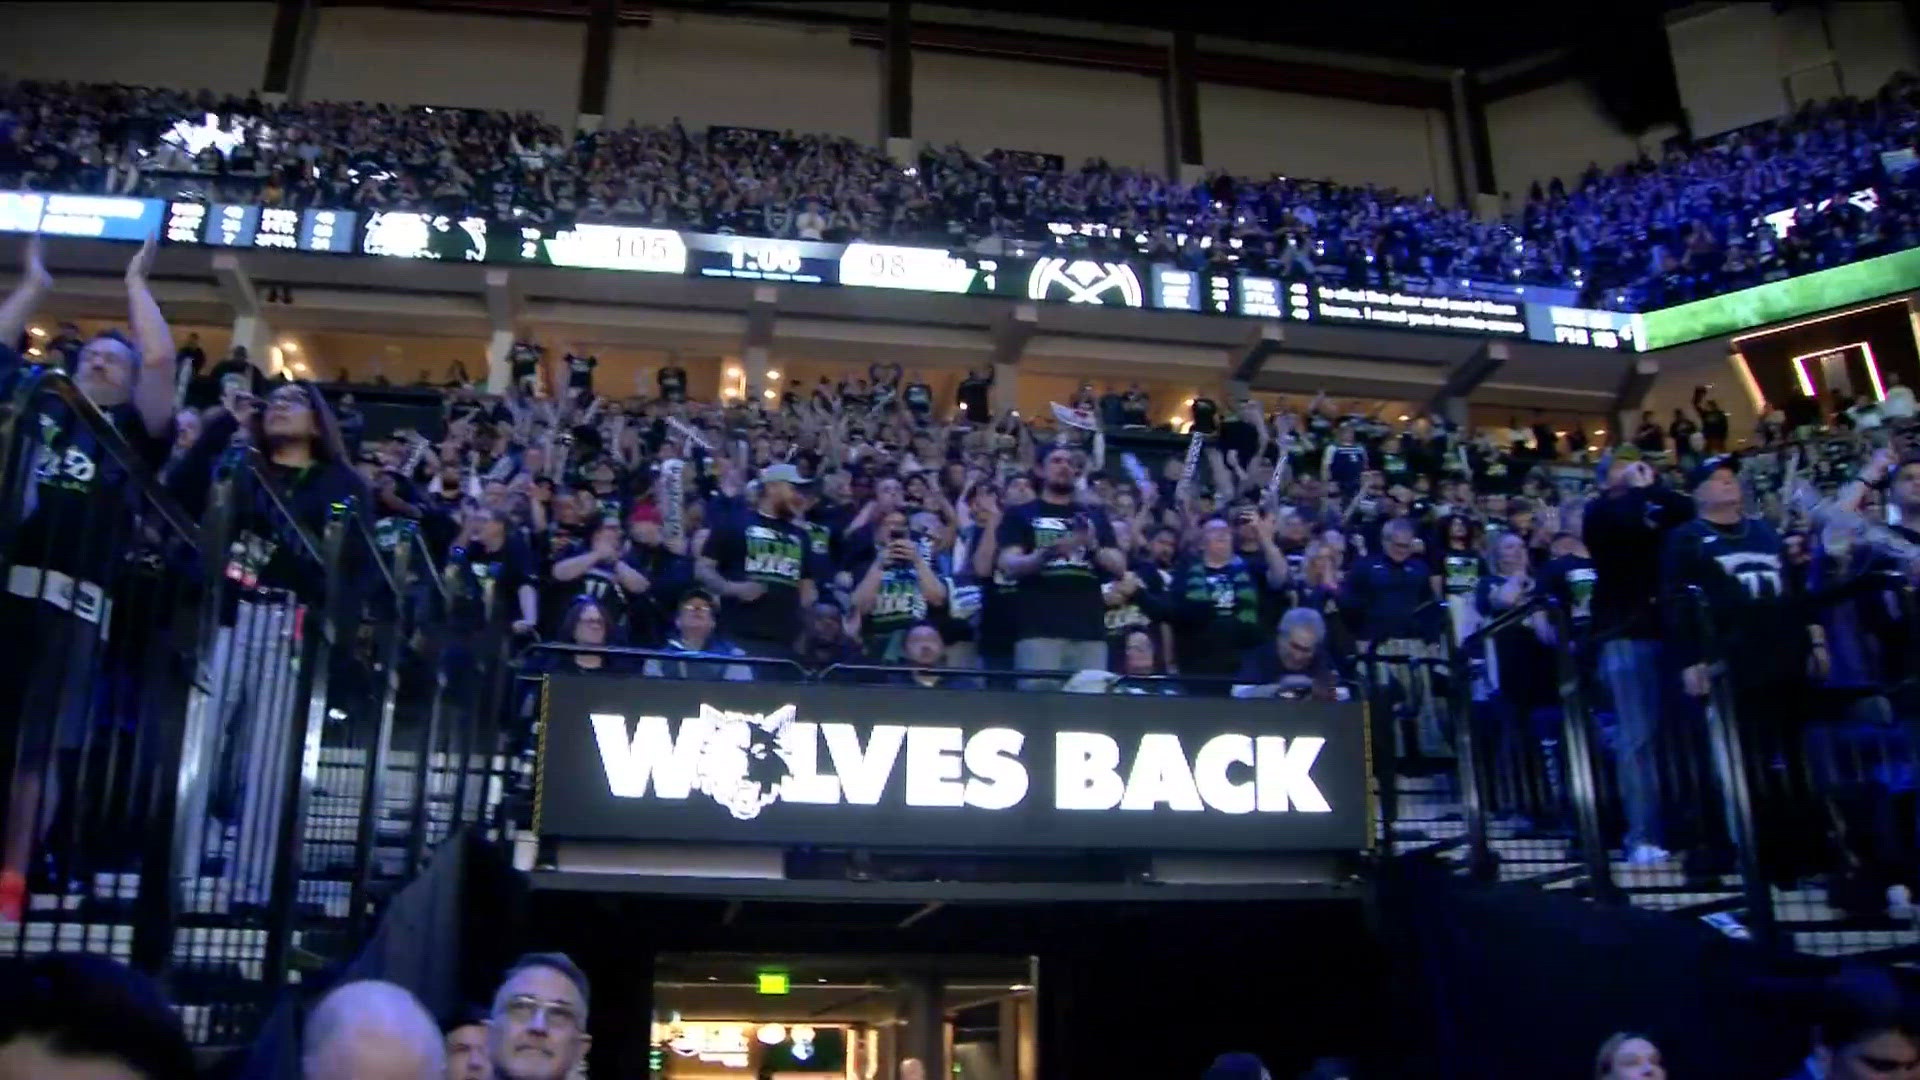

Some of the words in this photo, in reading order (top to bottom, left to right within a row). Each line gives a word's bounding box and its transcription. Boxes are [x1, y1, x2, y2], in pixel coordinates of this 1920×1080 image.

[614, 235, 668, 260] 105
[869, 252, 906, 278] 98
[590, 706, 1028, 815] WLVES
[1056, 732, 1331, 814] BACK
